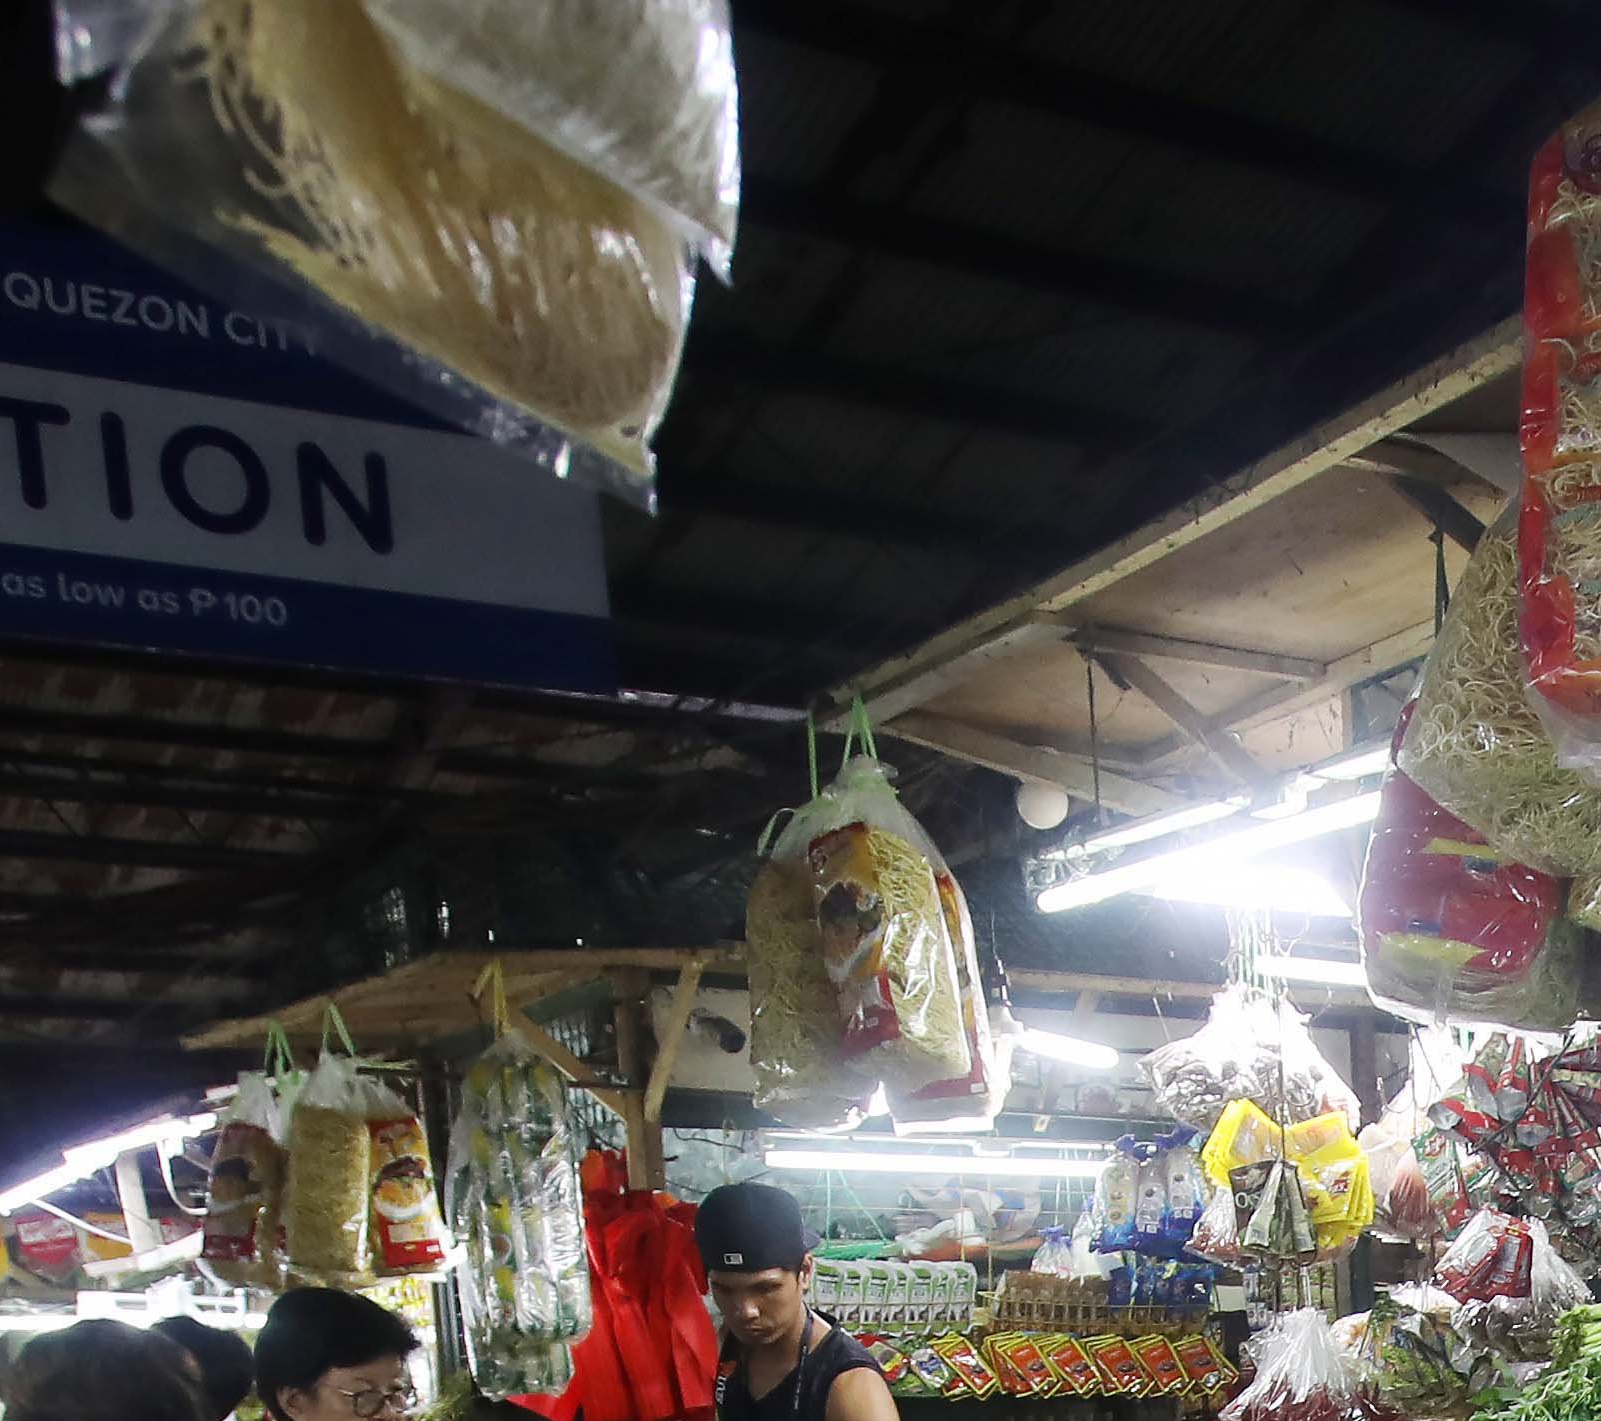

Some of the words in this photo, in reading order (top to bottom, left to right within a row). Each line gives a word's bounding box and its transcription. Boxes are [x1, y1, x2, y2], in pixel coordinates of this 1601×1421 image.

[4, 272, 210, 337] QUEZON
[224, 311, 321, 357] CITY
[3, 574, 46, 598] as
[58, 572, 126, 607] low
[137, 588, 180, 614] as
